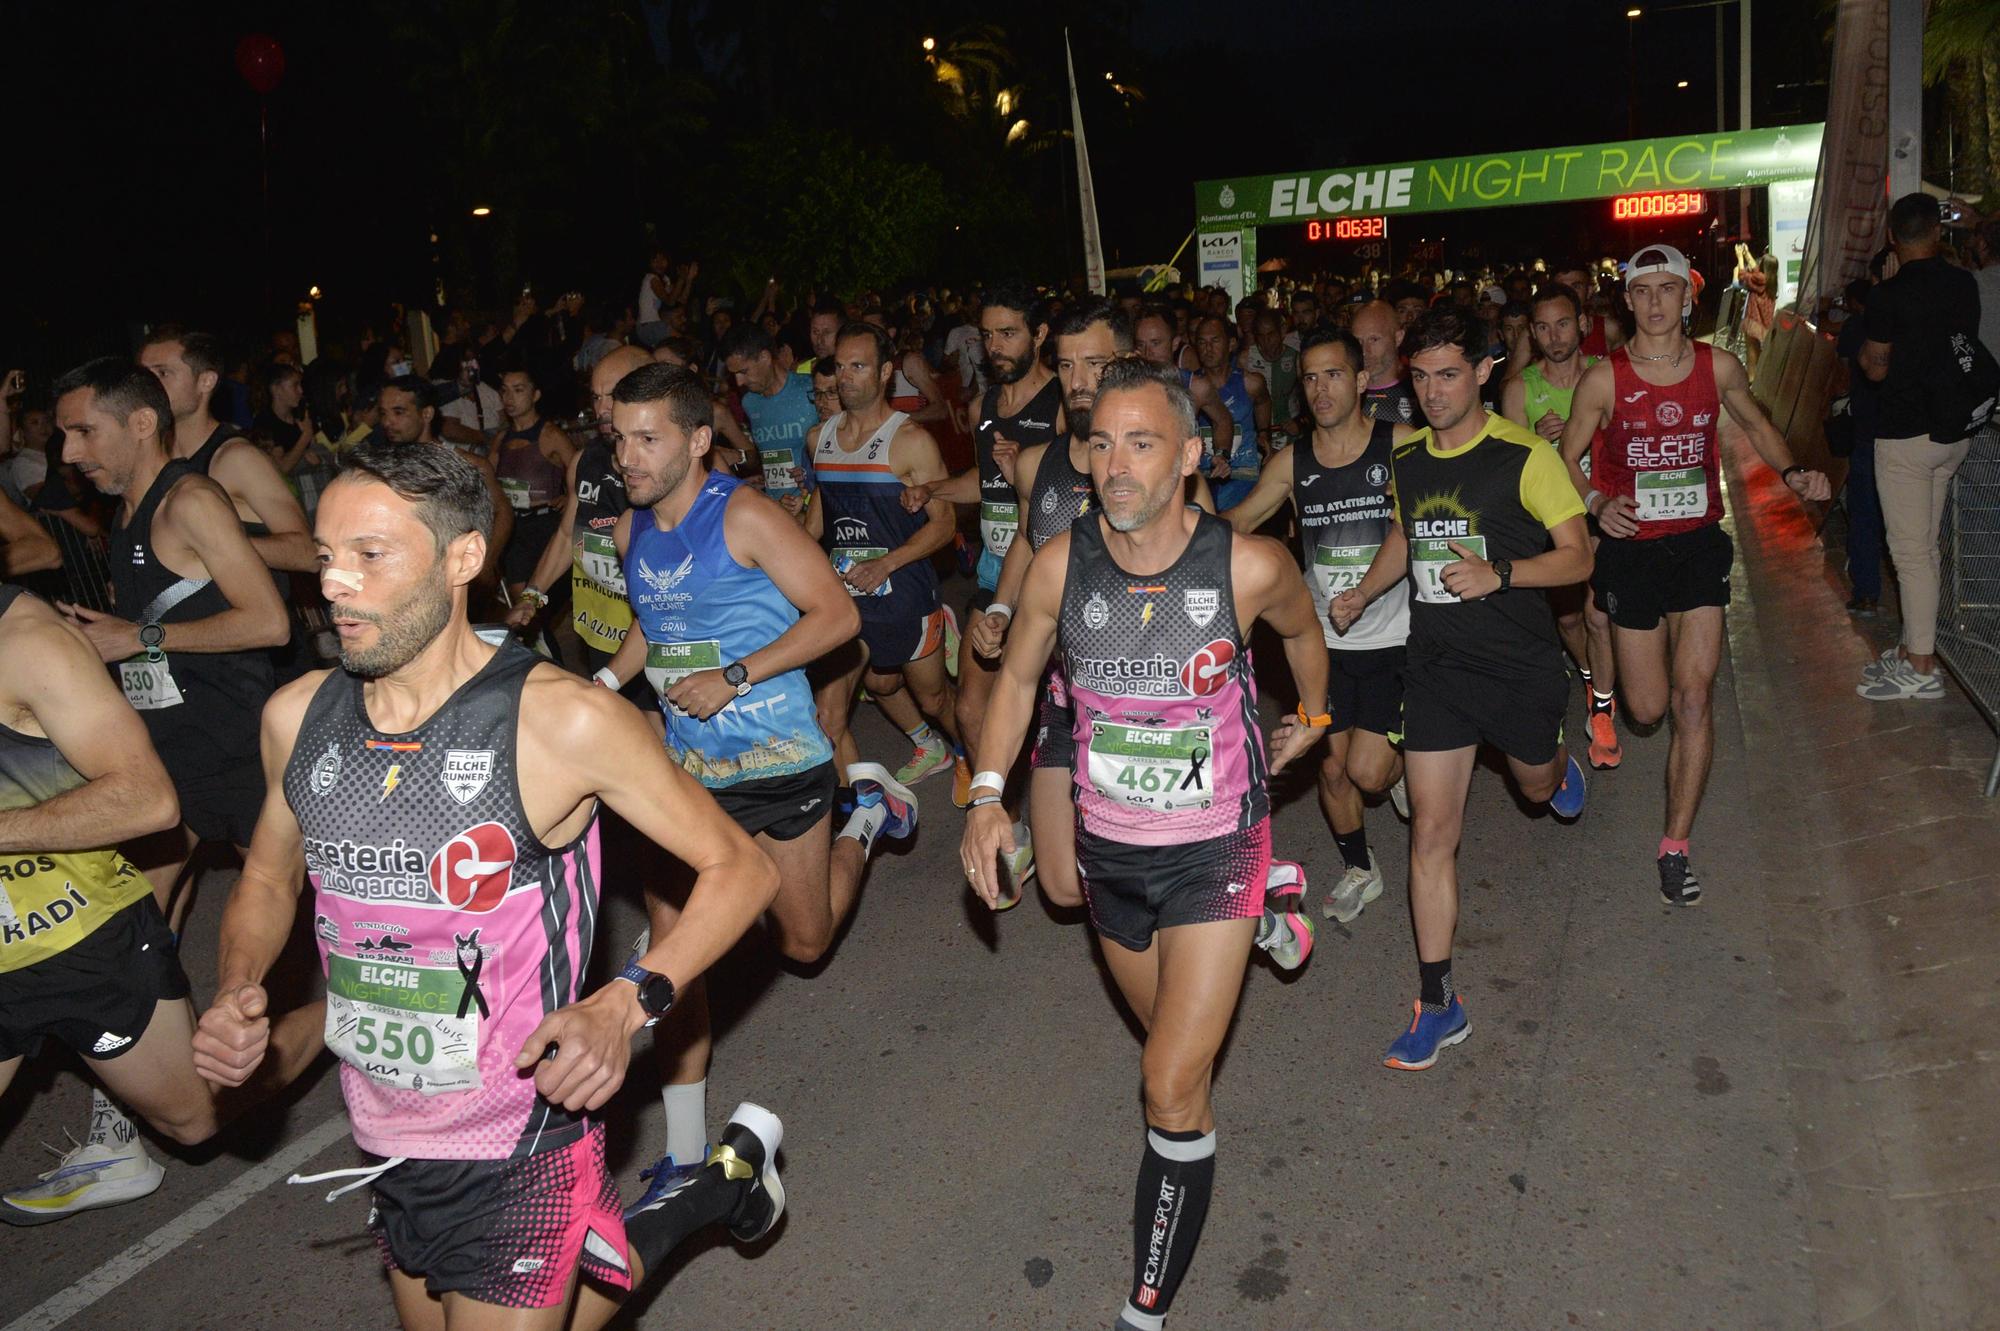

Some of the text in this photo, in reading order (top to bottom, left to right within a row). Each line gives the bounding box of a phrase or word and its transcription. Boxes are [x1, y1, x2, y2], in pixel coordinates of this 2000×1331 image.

[1269, 139, 1734, 217] ELCHE NIGHT RACE
[1201, 213, 1239, 222] Ajuntament
[1202, 236, 1238, 248] KIA
[1661, 432, 1703, 441] ATLETISMO
[1627, 437, 1705, 458] ELCHE
[1627, 453, 1703, 467] DECATLON
[765, 468, 785, 479] 794
[1660, 472, 1687, 480] ELCHE
[1304, 495, 1385, 514] CLUB ATLETISMO
[1649, 491, 1698, 508] 1123
[992, 505, 1014, 514] ELCHE
[1332, 508, 1392, 524] TORREVIEJA
[836, 526, 869, 541] APM
[1415, 520, 1468, 537] ELCHE
[1332, 549, 1360, 558] ELCHE
[1328, 572, 1366, 588] 725
[660, 622, 687, 632] GRAU
[661, 646, 691, 657] ELCHE
[124, 671, 154, 691] 530
[1125, 730, 1172, 745] ELCHE
[448, 761, 488, 772] ELCHE
[441, 772, 491, 782] RUNNERS
[1117, 765, 1183, 793] 467
[360, 965, 420, 989] ELCHE
[341, 978, 449, 1011] NIGHT RACE
[366, 1003, 402, 1018] CARRERA
[93, 1036, 132, 1052] adidas
[355, 1016, 435, 1066] 550
[366, 1062, 400, 1076] KIA
